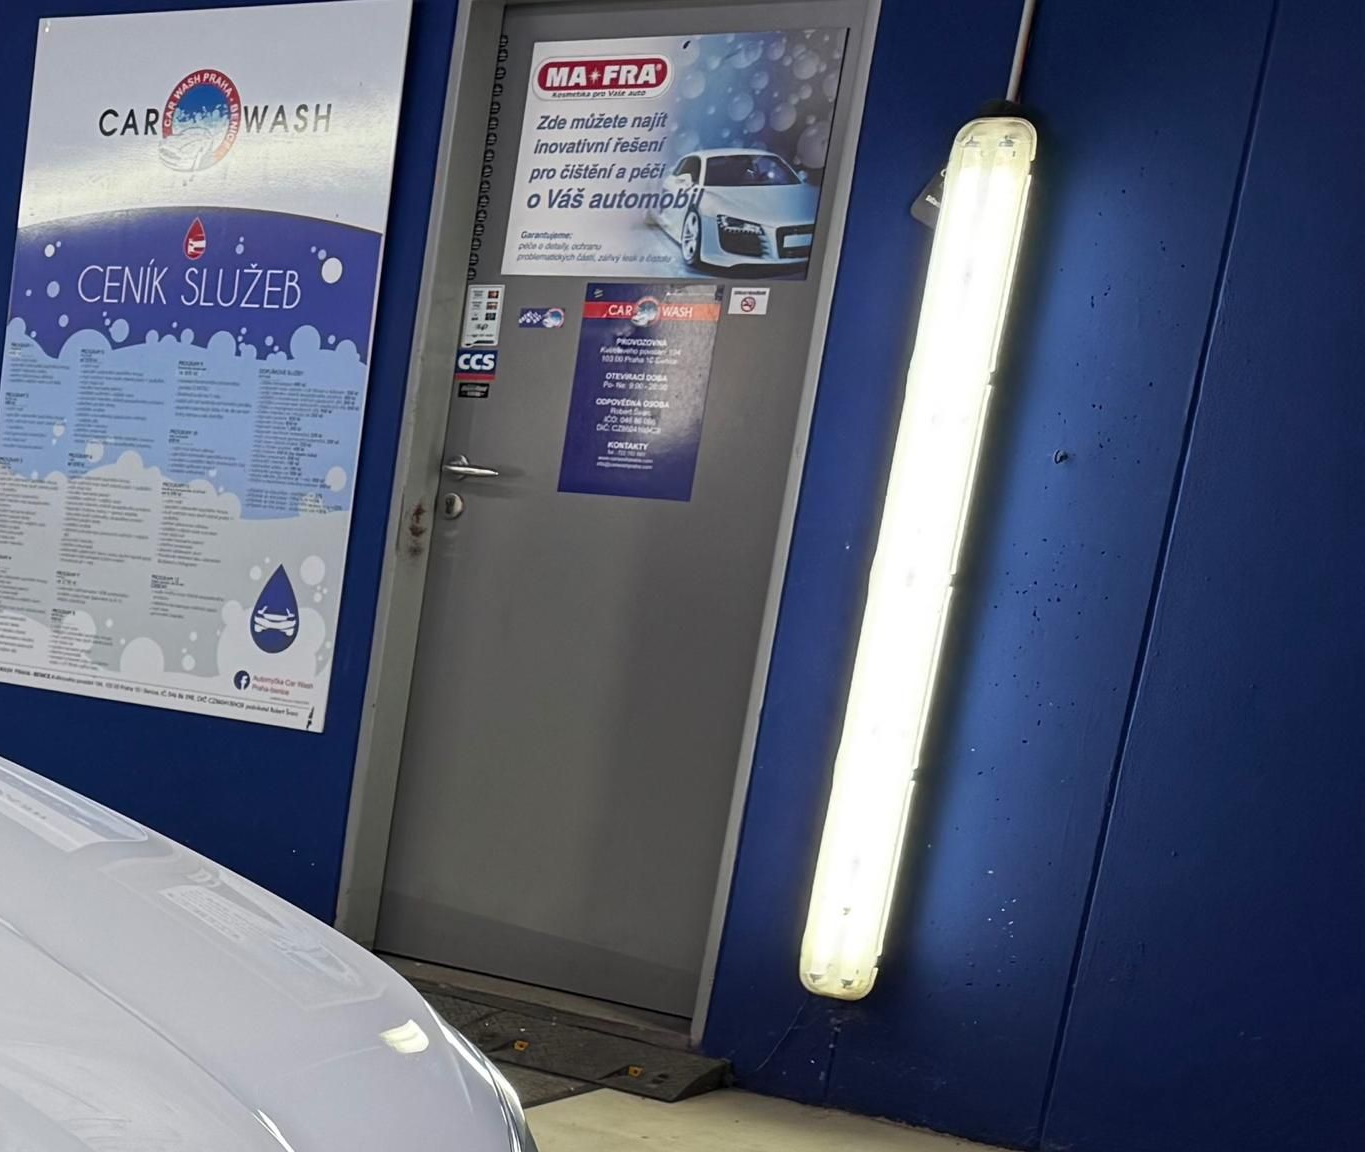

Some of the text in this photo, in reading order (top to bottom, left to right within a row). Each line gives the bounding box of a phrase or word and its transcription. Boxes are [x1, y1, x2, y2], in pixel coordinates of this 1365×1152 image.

[174, 74, 201, 99] WASH
[203, 73, 233, 97] PRAHA
[98, 103, 332, 137] CAR WASH
[537, 111, 669, 132] Zde můžete najít
[534, 136, 667, 155] inovativní řešení
[529, 163, 665, 183] pro čištění a péči
[526, 188, 705, 210] o Váš automobil
[77, 259, 302, 310] CENÍK SLUŽEB
[608, 304, 693, 318] CAR WASH
[458, 353, 495, 371] CCS
